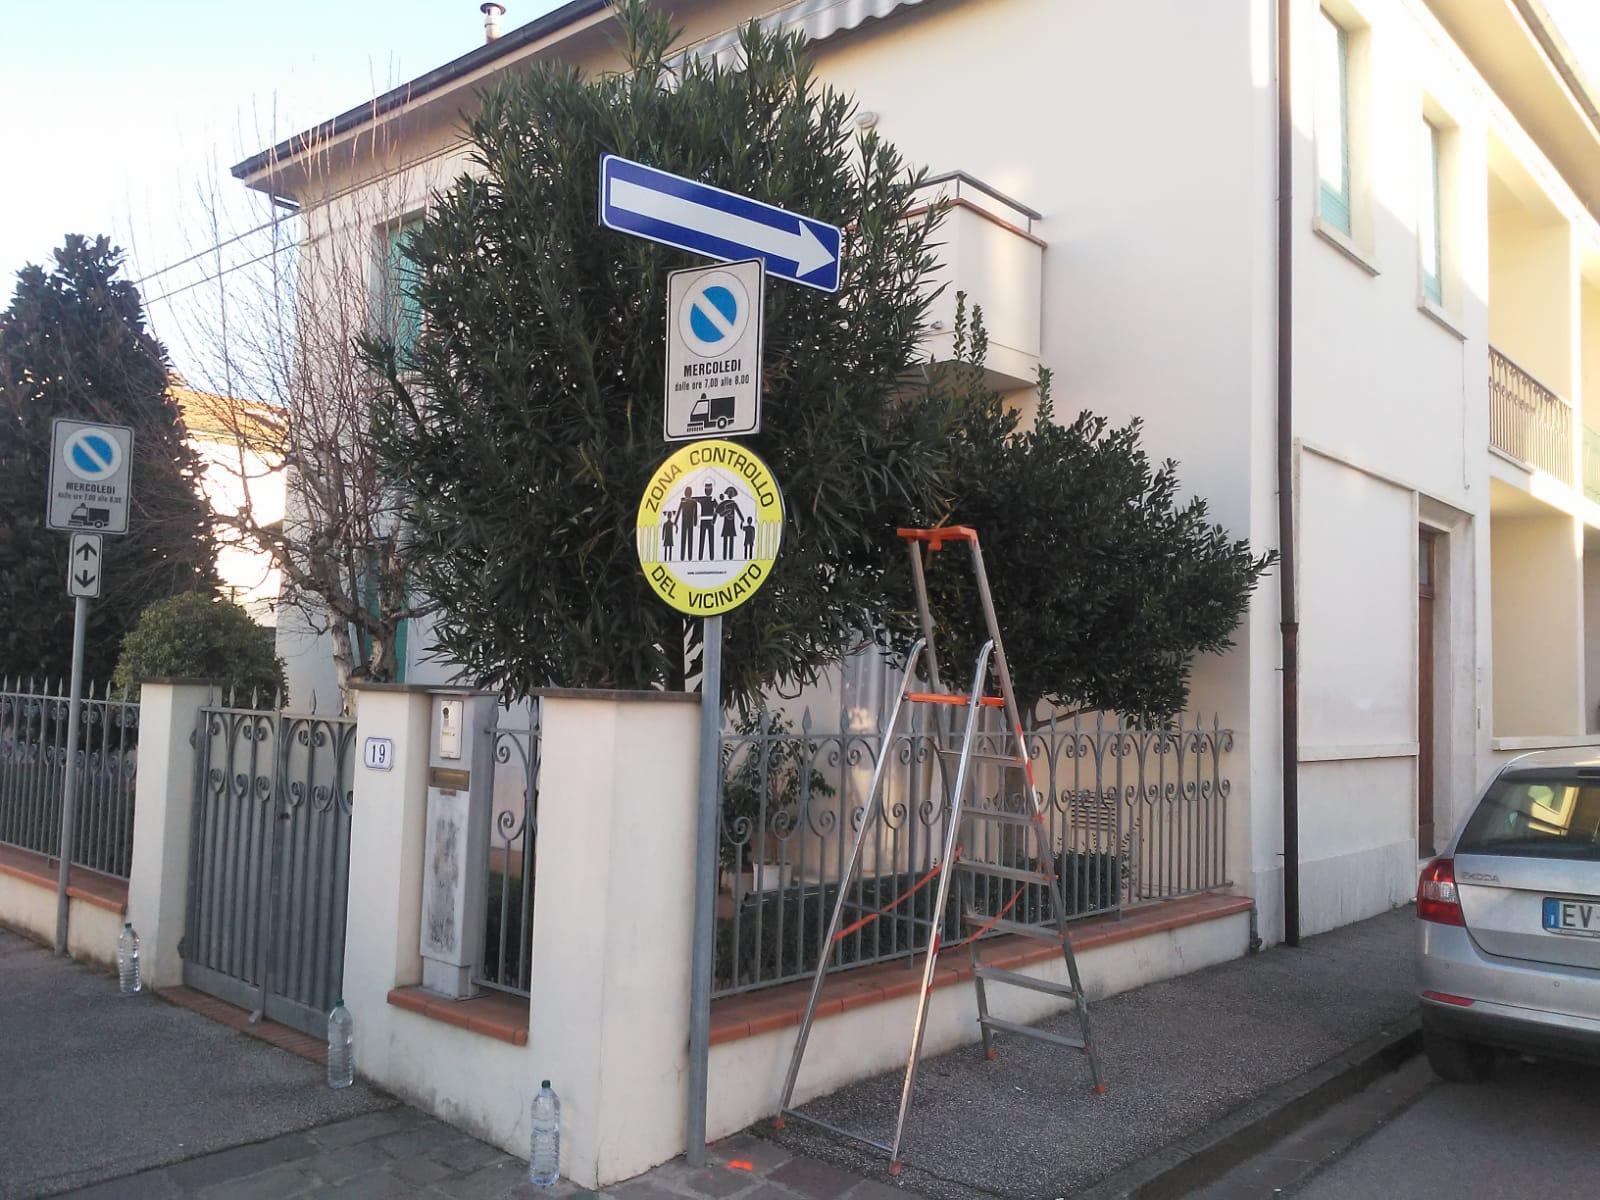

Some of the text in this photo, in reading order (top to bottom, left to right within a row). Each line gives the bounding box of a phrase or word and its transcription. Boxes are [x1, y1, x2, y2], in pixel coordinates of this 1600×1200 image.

[684, 359, 741, 377] MERCOLEDI
[675, 382, 690, 391] dalle
[692, 382, 702, 390] ore
[721, 376, 732, 387] alle
[66, 482, 116, 494] MERCOLEDI
[646, 447, 774, 513] ZONA CONTROLLO
[651, 563, 762, 609] DEL VICINATO
[372, 744, 386, 764] 19
